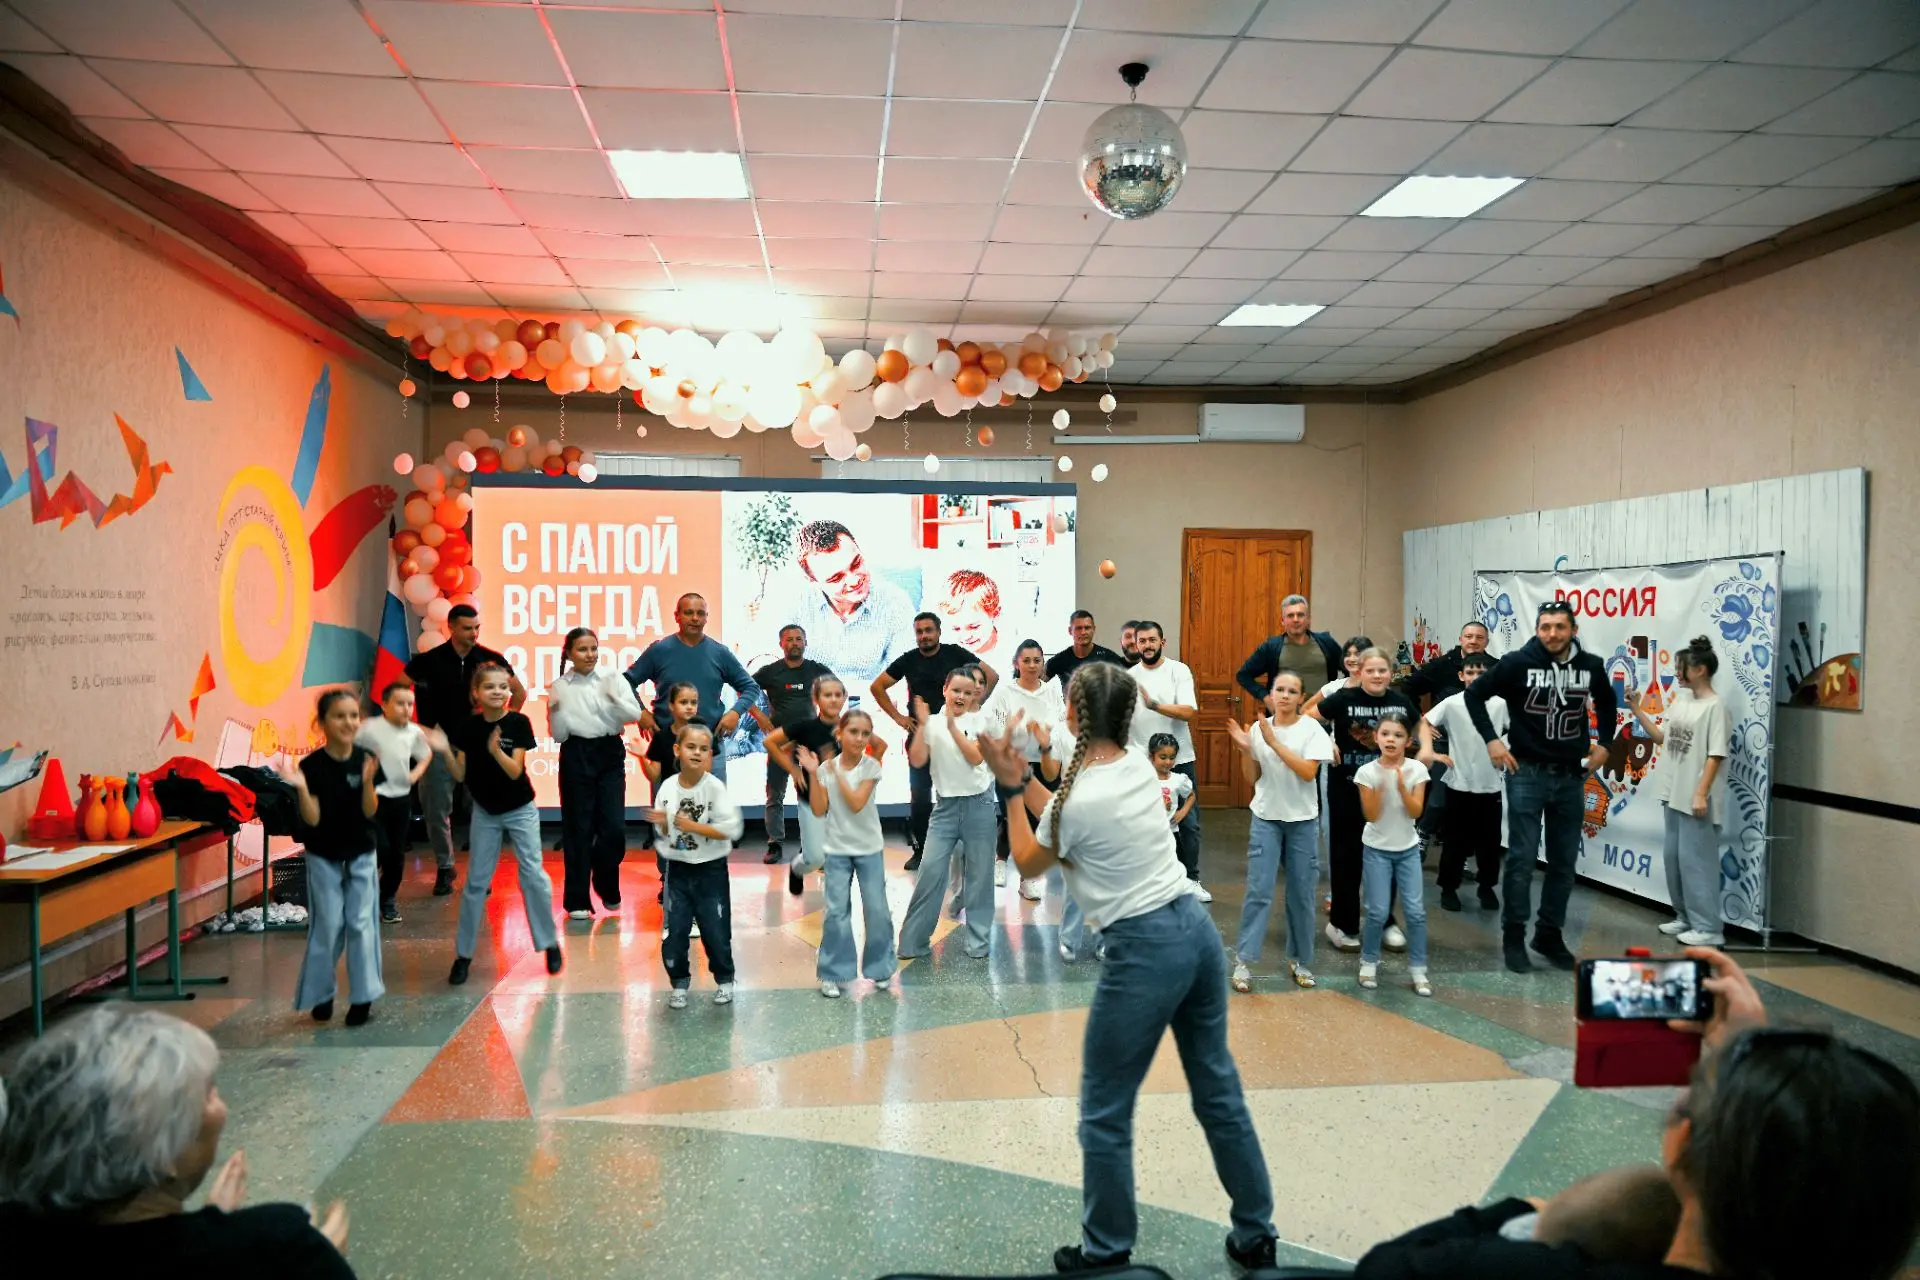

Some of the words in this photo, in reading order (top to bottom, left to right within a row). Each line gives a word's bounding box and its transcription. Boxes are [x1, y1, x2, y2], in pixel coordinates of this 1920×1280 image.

[502, 522, 527, 573] С
[540, 516, 678, 575] ПАПОЙ
[503, 584, 663, 641] ВСЕГДА
[1524, 687, 1590, 740] 42
[1603, 844, 1652, 878] МОЯ
